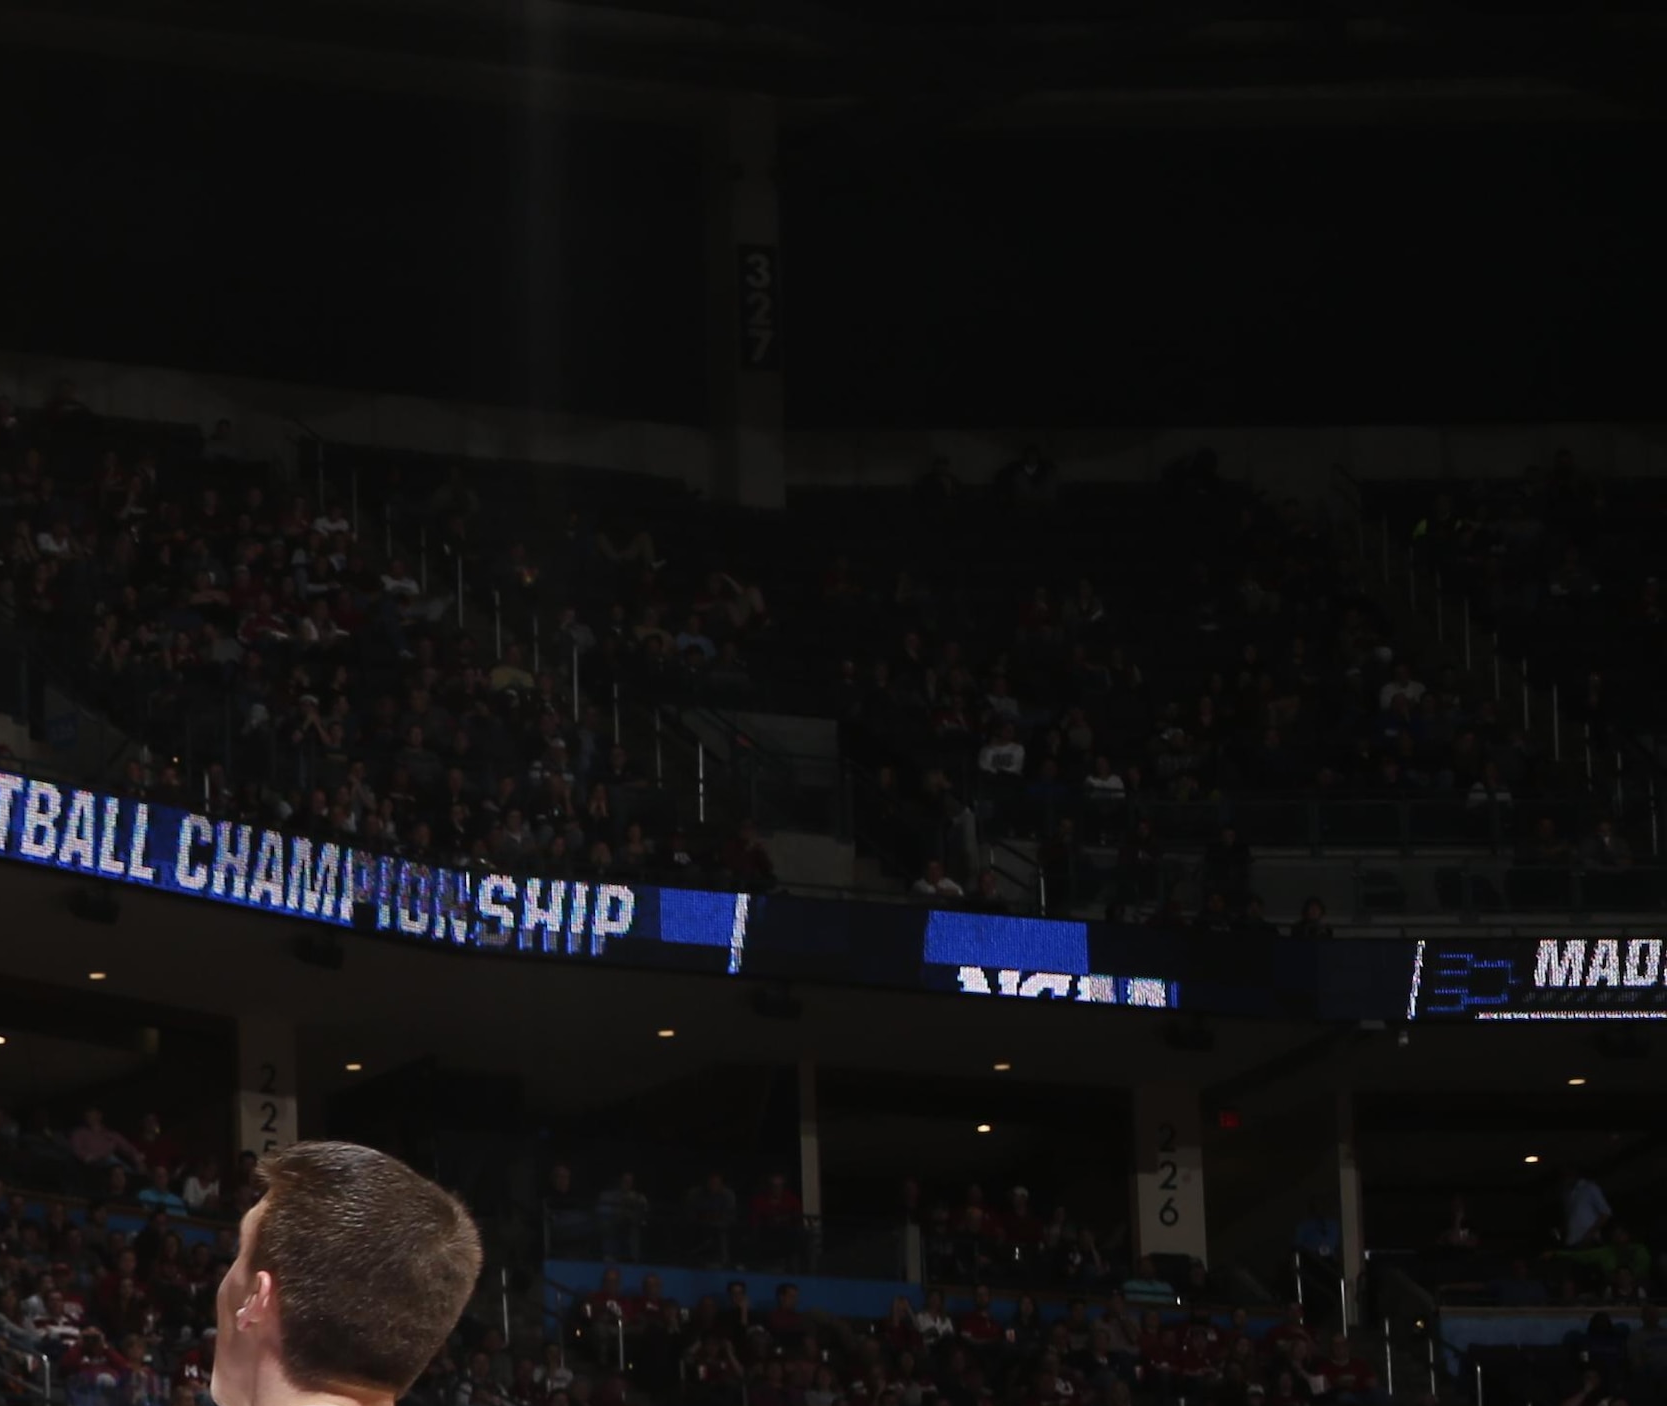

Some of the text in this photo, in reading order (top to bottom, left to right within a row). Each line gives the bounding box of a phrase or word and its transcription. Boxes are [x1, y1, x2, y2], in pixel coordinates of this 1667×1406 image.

[746, 253, 775, 363] 327
[174, 811, 637, 955] CHAMPIONSHIP
[1158, 1123, 1180, 1225] 226
